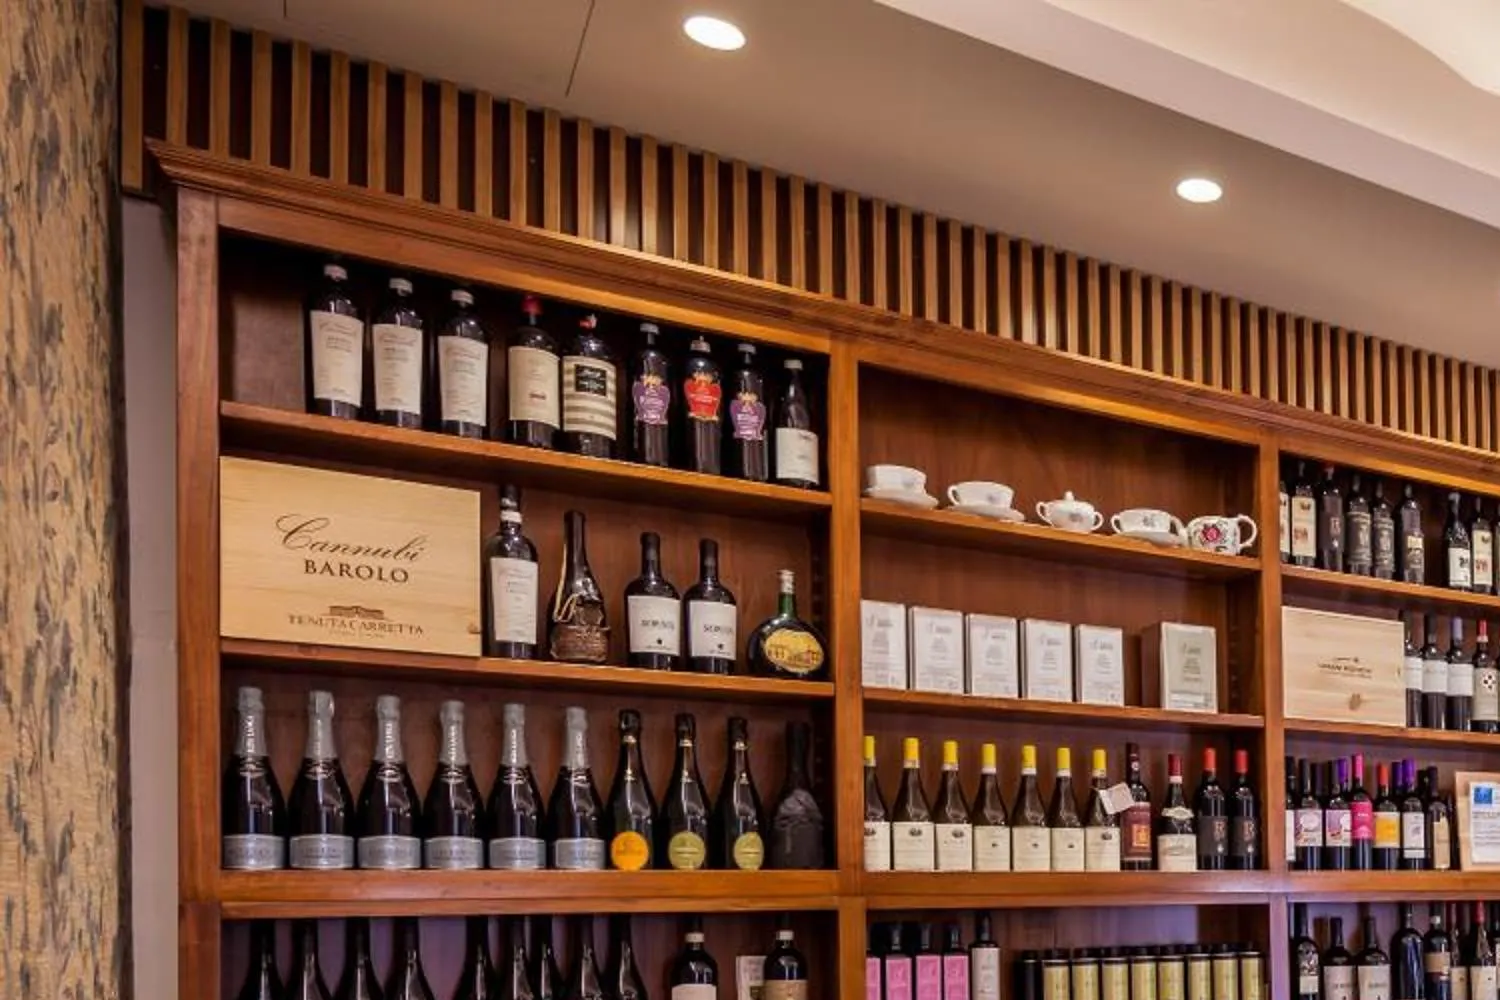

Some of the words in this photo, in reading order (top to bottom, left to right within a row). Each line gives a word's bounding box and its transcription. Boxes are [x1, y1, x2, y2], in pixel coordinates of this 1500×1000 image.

[275, 513, 428, 562] Cannubi
[303, 559, 410, 583] BAROLO
[288, 614, 348, 629] TENUTA
[349, 619, 424, 635] CARRETTA
